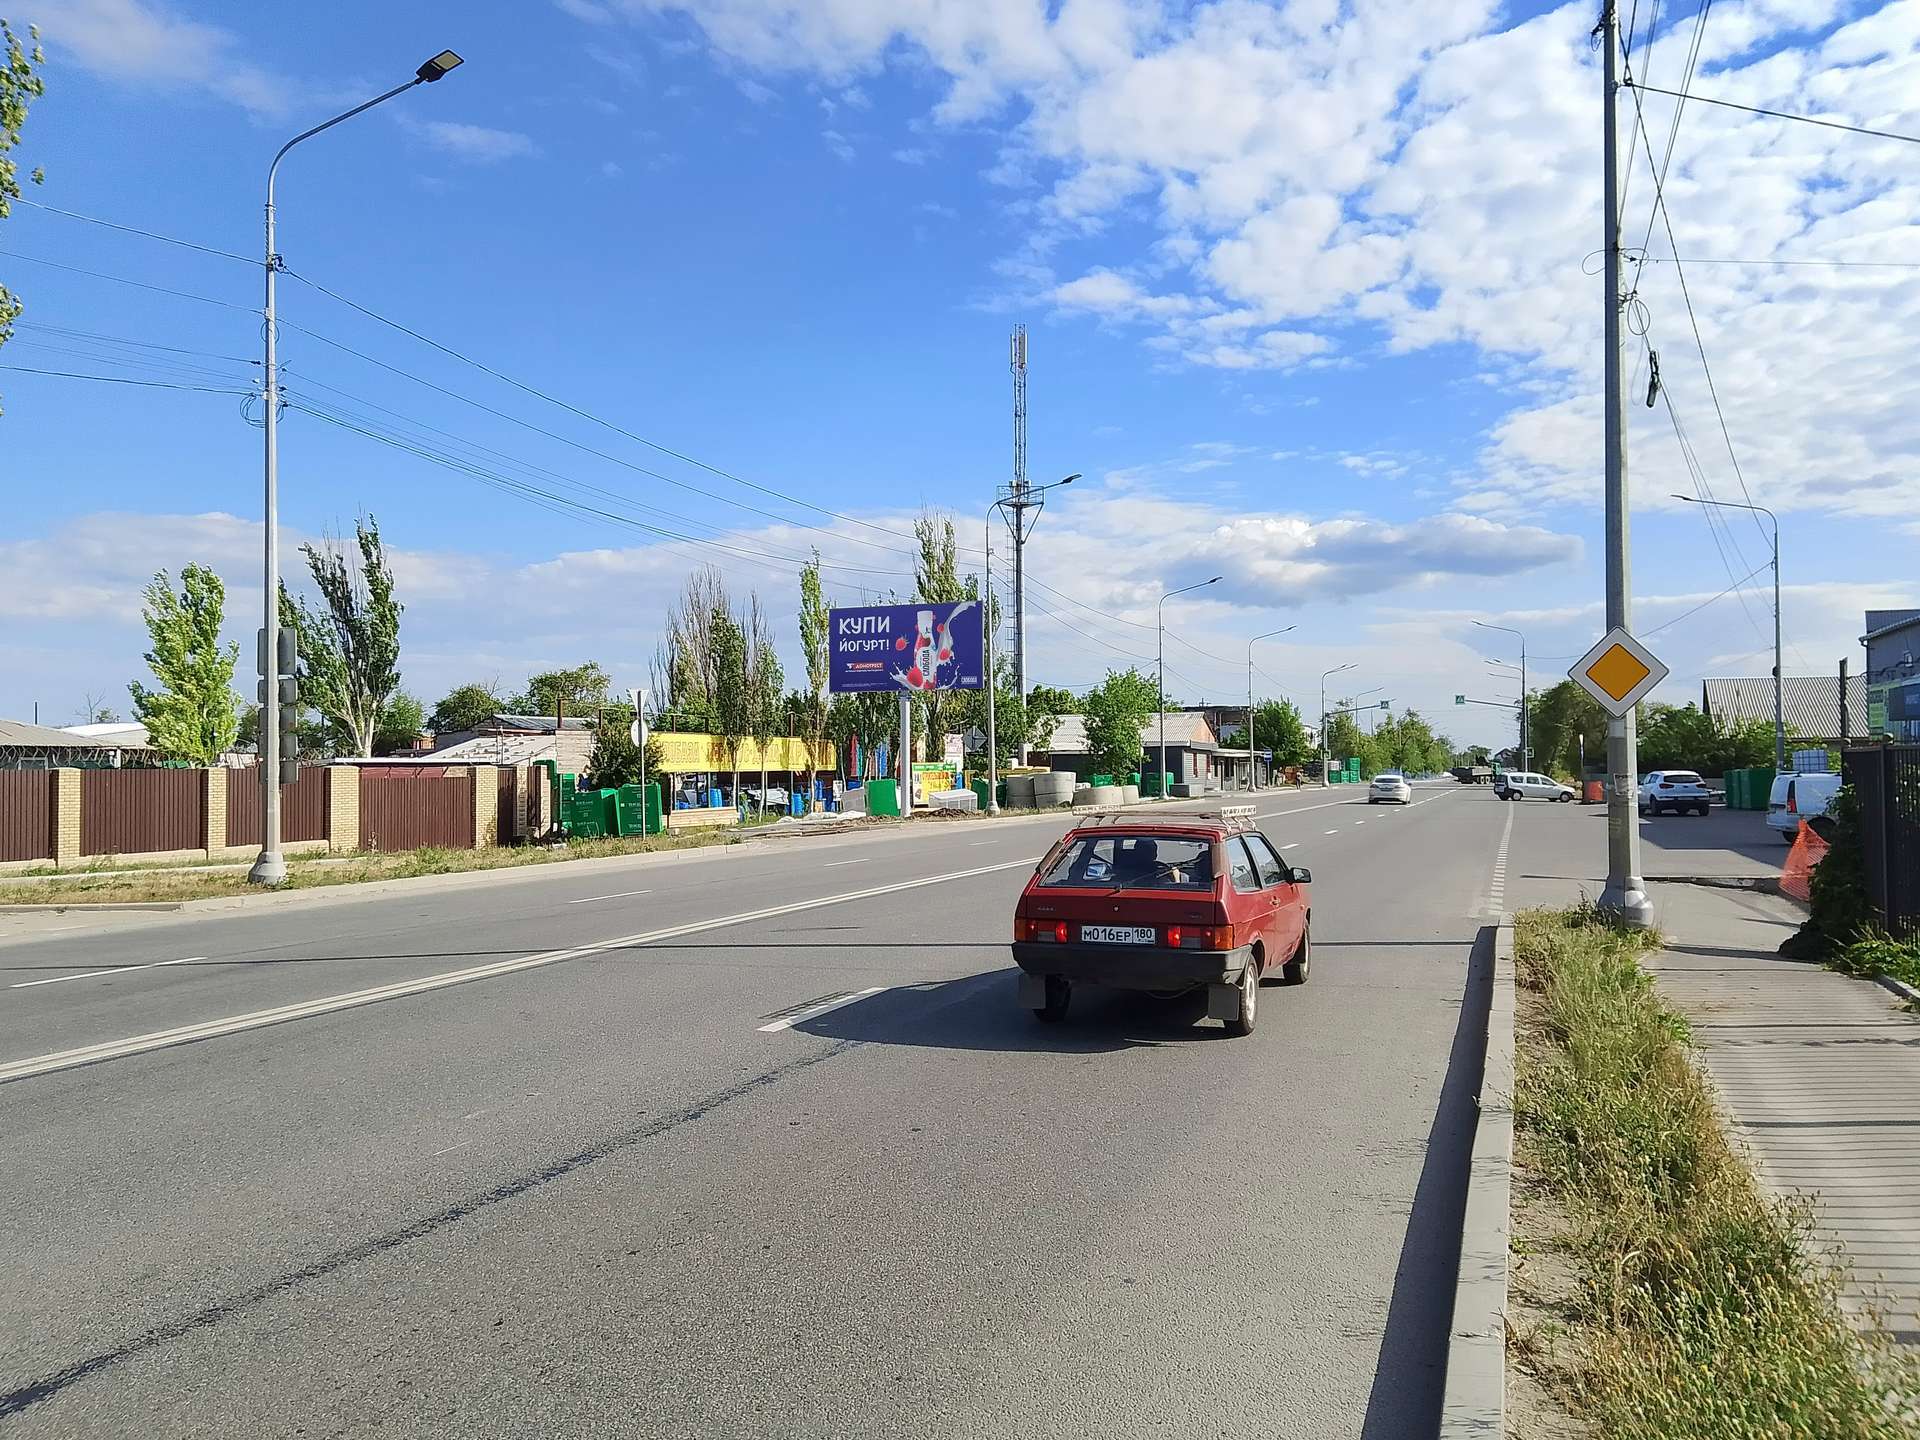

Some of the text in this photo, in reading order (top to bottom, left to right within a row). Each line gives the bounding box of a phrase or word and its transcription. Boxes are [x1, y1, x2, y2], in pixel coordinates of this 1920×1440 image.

[839, 616, 890, 635] КУПИ
[839, 638, 890, 652] ЙОГУРТ!
[922, 649, 930, 677] СЛОБОДА
